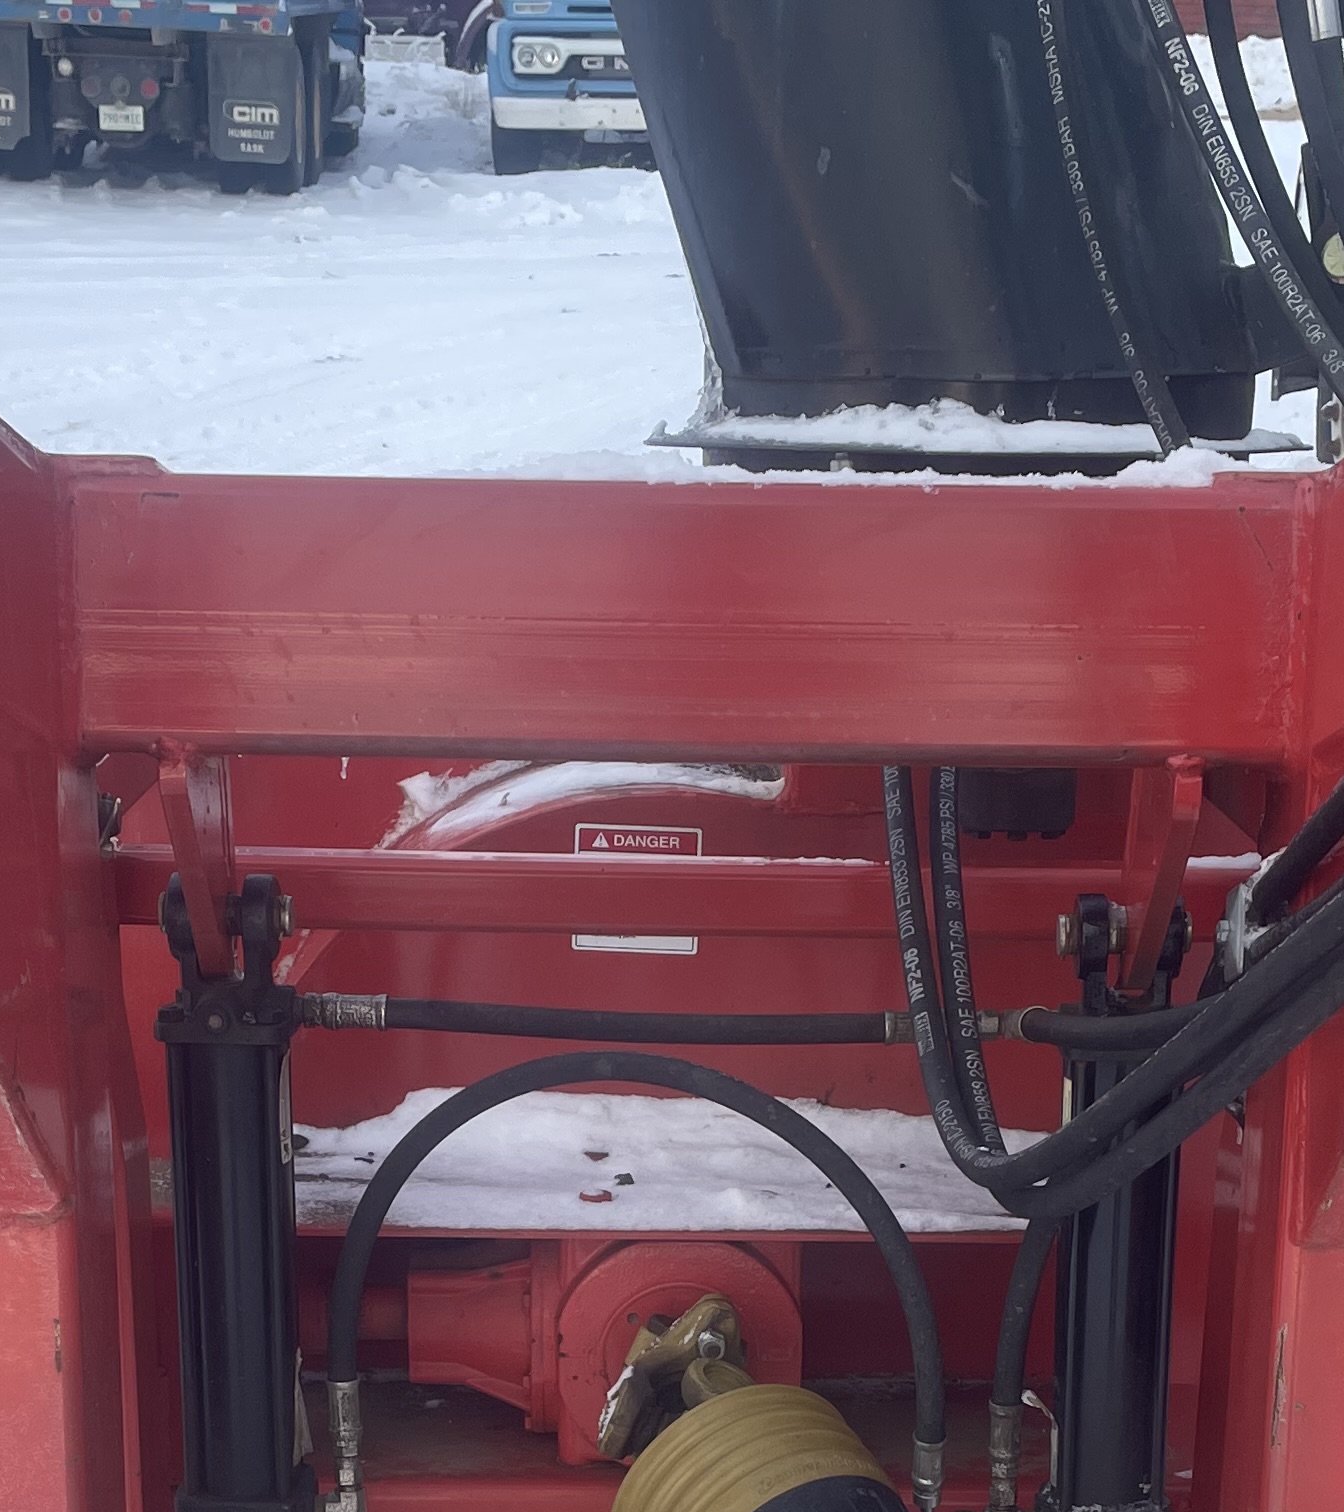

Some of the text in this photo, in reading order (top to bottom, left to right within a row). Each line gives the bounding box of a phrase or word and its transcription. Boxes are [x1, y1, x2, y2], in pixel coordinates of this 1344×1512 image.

[1164, 36, 1200, 96] NF2-06
[1192, 103, 1216, 137] DIN
[1206, 134, 1240, 188] EN853
[1229, 186, 1257, 222] 2SN
[1251, 227, 1279, 264] SAE
[1269, 261, 1326, 345] 100R2AT-06
[885, 787, 903, 820] SAE
[612, 833, 681, 850] DANGER
[888, 827, 907, 857] 2SN
[940, 820, 957, 850] 4785
[941, 851, 959, 874] WP
[897, 909, 916, 941] DIN
[903, 946, 926, 1004] NF2-06
[948, 919, 973, 1003] 100R2AT-06
[958, 1007, 979, 1039] SAE
[963, 1050, 984, 1079] 2SN
